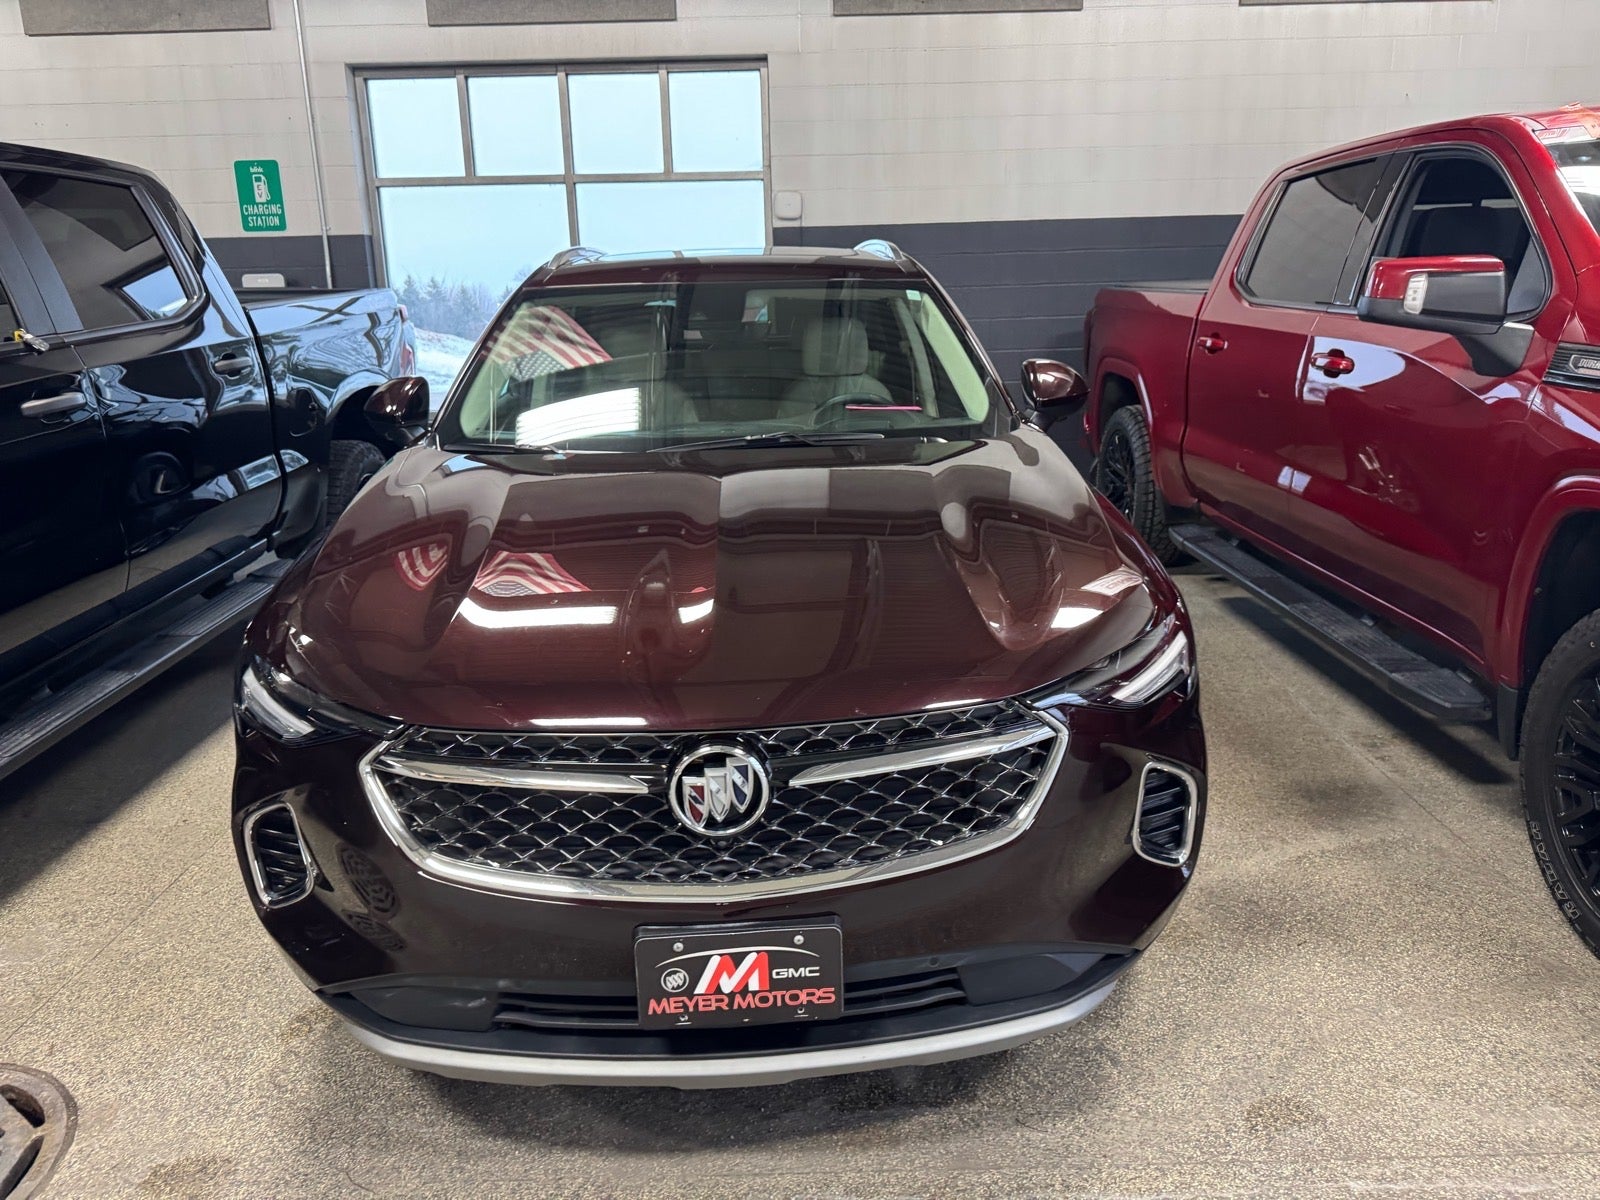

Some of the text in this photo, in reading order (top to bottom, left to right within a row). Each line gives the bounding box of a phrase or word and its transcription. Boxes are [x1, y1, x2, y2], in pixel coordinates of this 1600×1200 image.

[243, 204, 282, 215] CHARGING
[248, 216, 280, 227] STATION
[772, 967, 820, 979] GMC
[648, 987, 836, 1015] MEYER MOTORS
